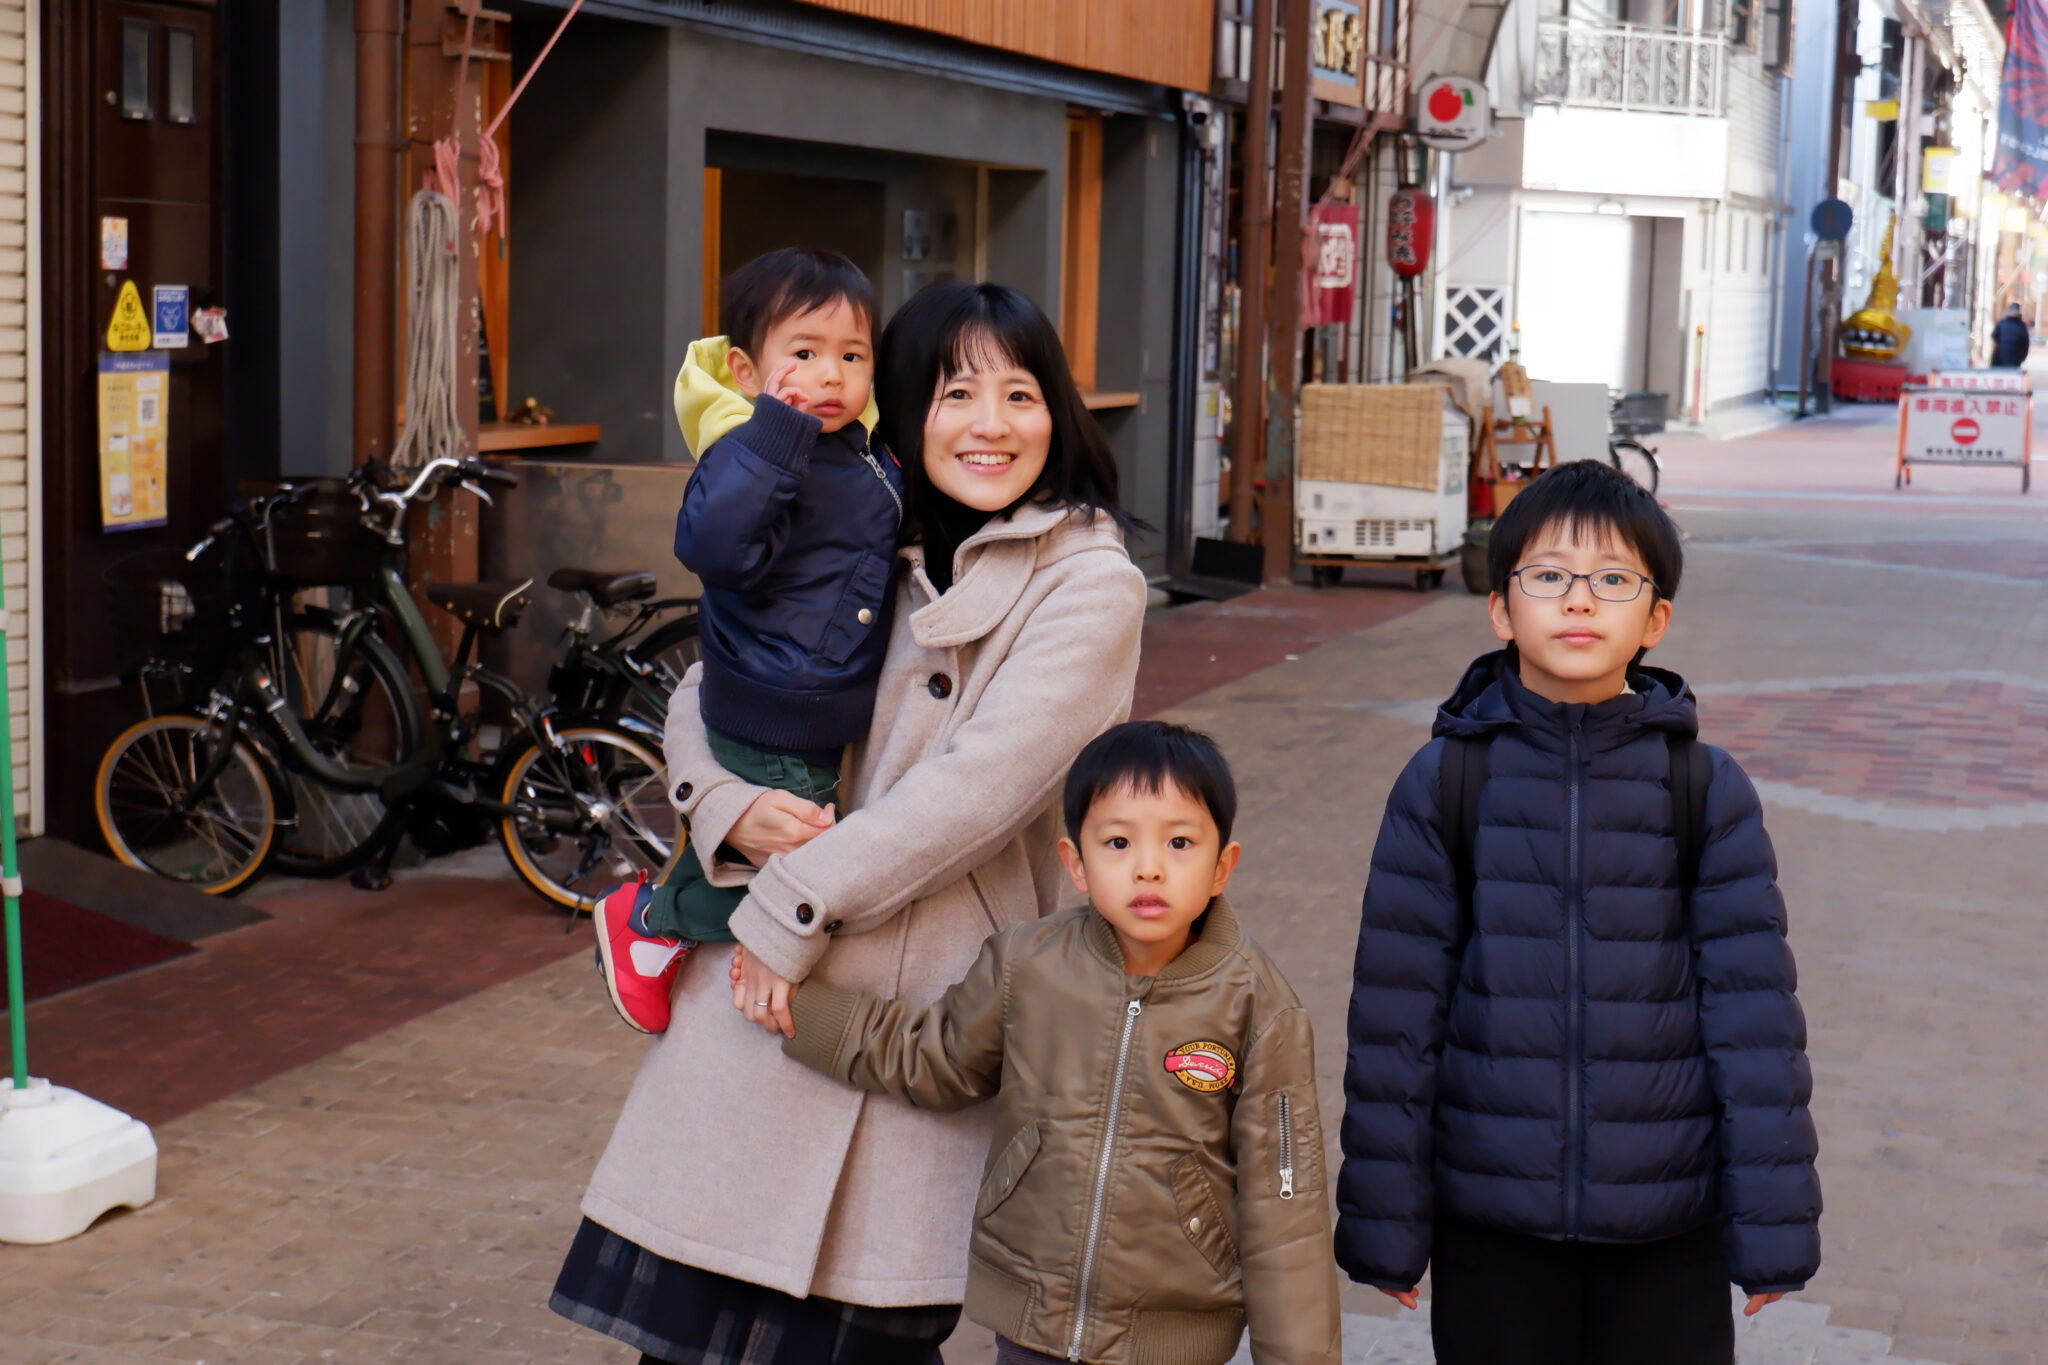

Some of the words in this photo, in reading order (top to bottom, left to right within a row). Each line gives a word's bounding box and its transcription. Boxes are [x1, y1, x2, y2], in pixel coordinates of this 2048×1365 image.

[1915, 398, 2019, 417] 車両進入禁止
[1180, 1043, 1200, 1054] YOUR
[1203, 1042, 1233, 1061] FORTUNE
[1208, 1078, 1228, 1089] FROM
